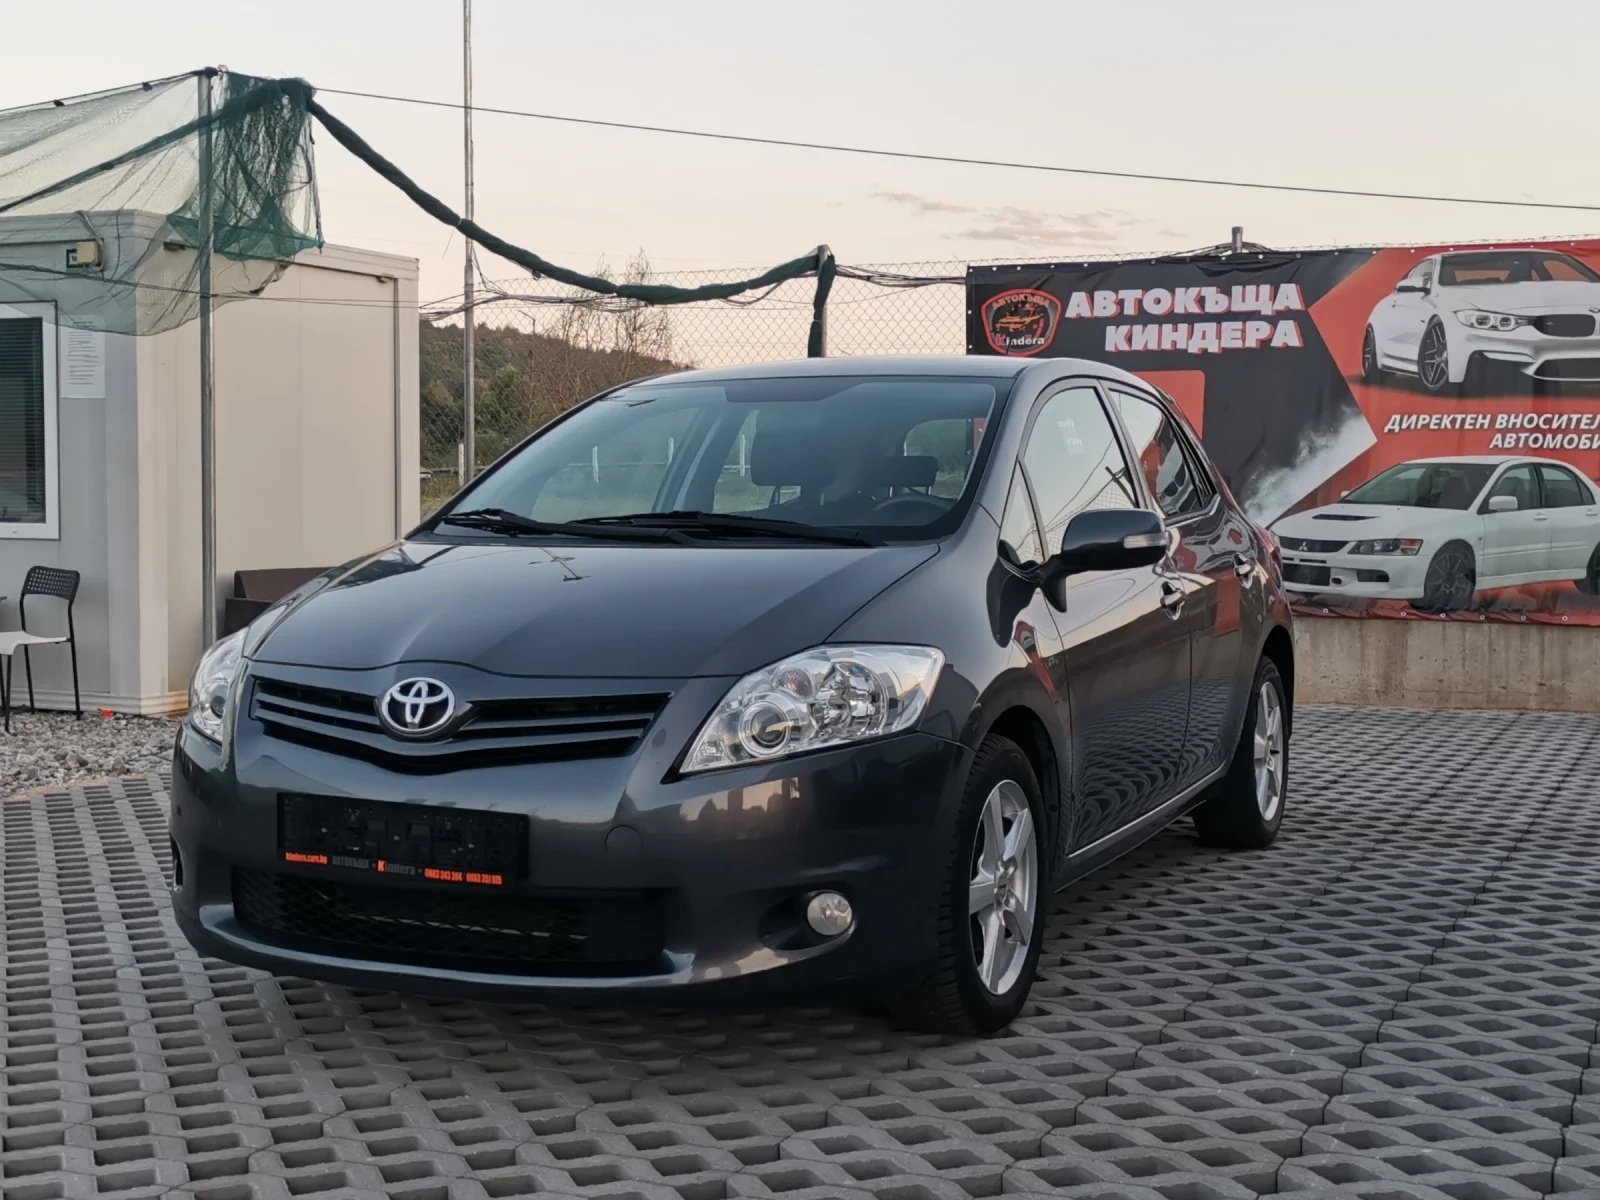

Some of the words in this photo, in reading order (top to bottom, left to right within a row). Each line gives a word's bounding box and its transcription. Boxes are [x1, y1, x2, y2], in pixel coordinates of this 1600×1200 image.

[1065, 283, 1304, 318] АВТОКЪЩА
[996, 334, 1045, 346] Kindera
[1105, 320, 1304, 353] КИНДЕРА
[1384, 414, 1491, 433] ДИРЕКТЕН
[1495, 413, 1600, 430] ВНОСИТЕЛ
